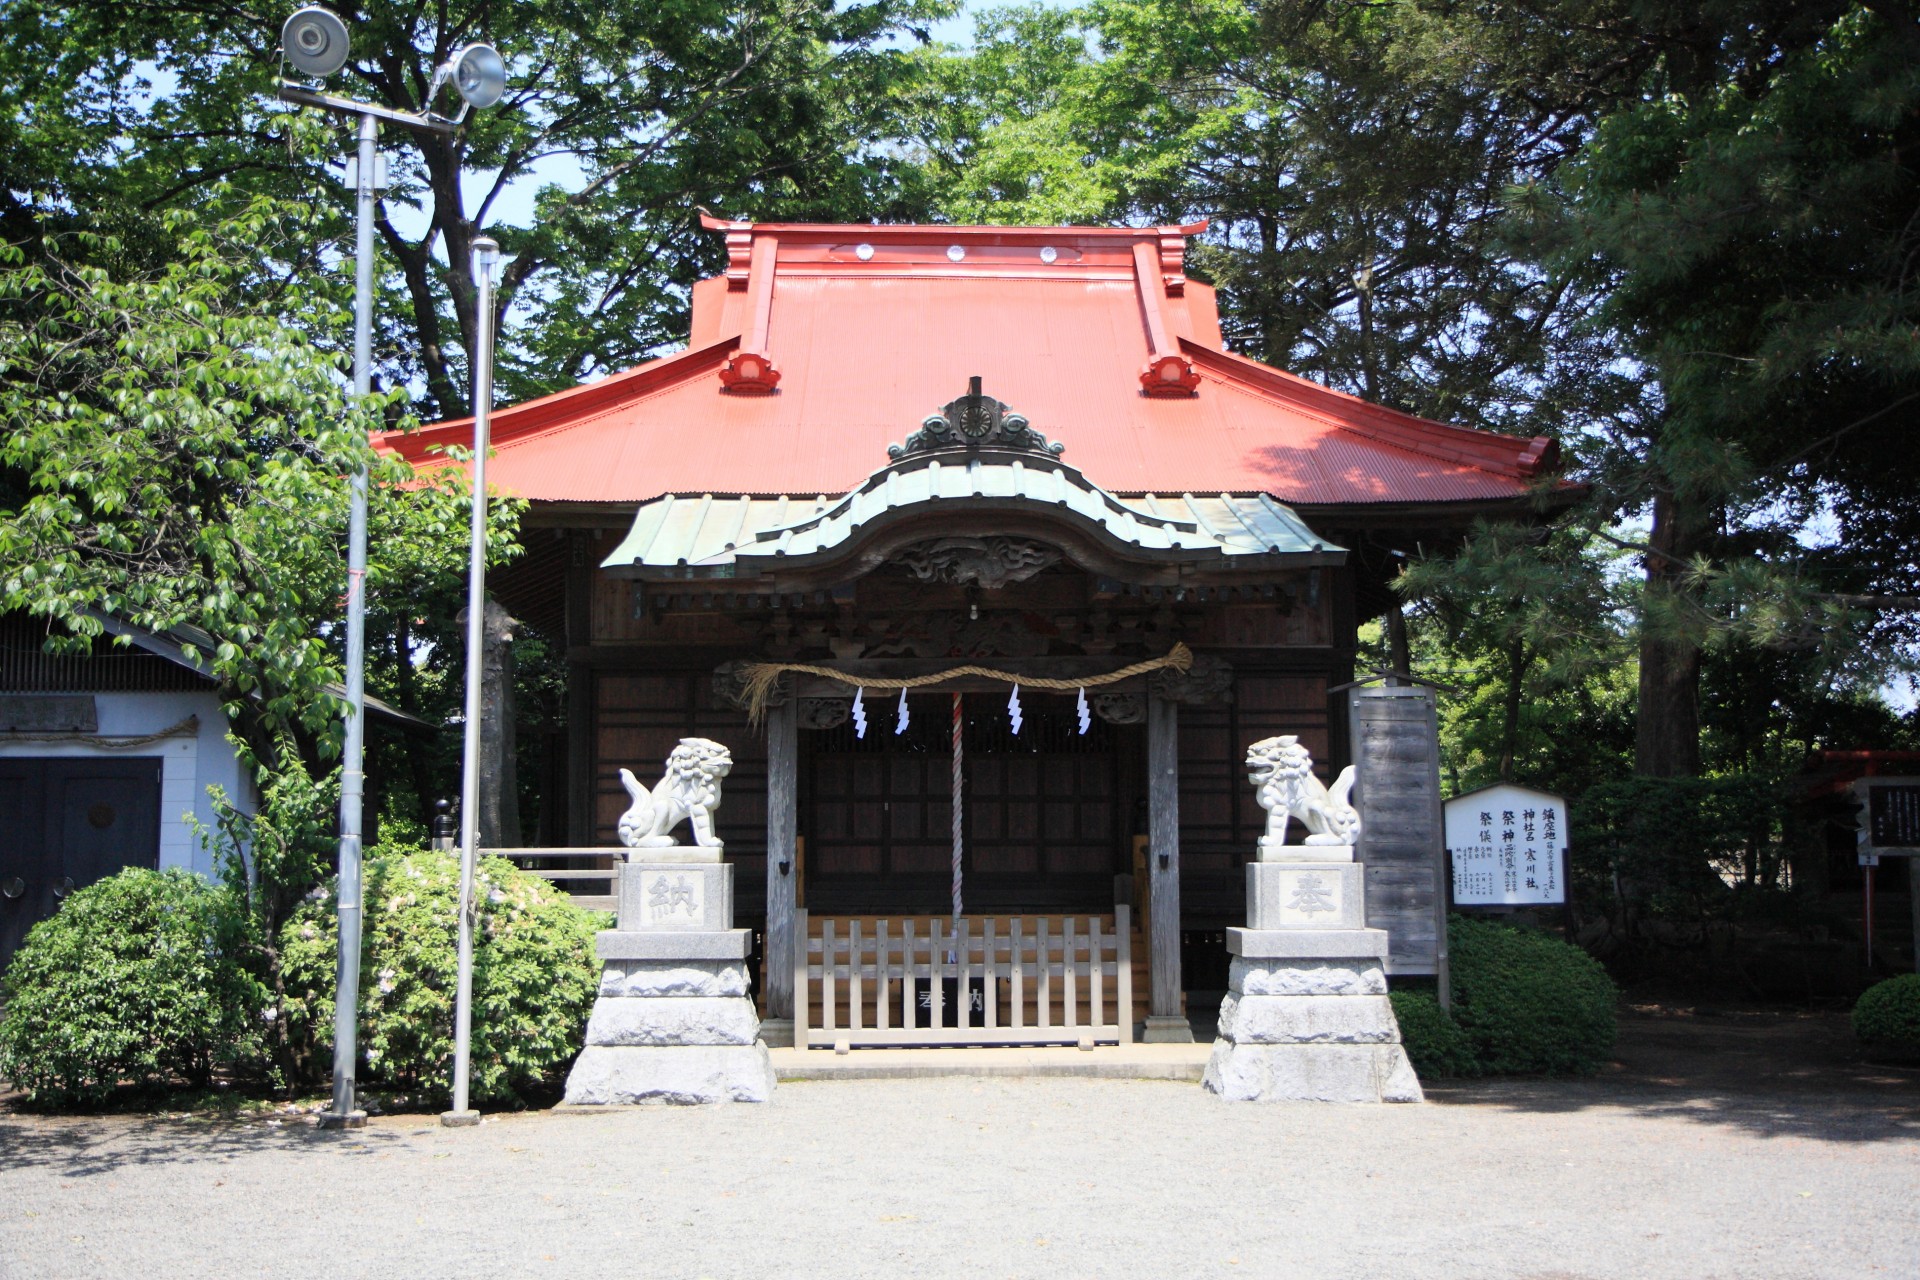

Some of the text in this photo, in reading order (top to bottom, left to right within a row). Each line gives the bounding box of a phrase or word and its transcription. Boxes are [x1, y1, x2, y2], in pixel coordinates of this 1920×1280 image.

[1502, 810, 1515, 843] 祭神
[1522, 808, 1537, 889] 神社名 寒川社
[648, 874, 699, 921] 納
[1284, 873, 1337, 919] 奉
